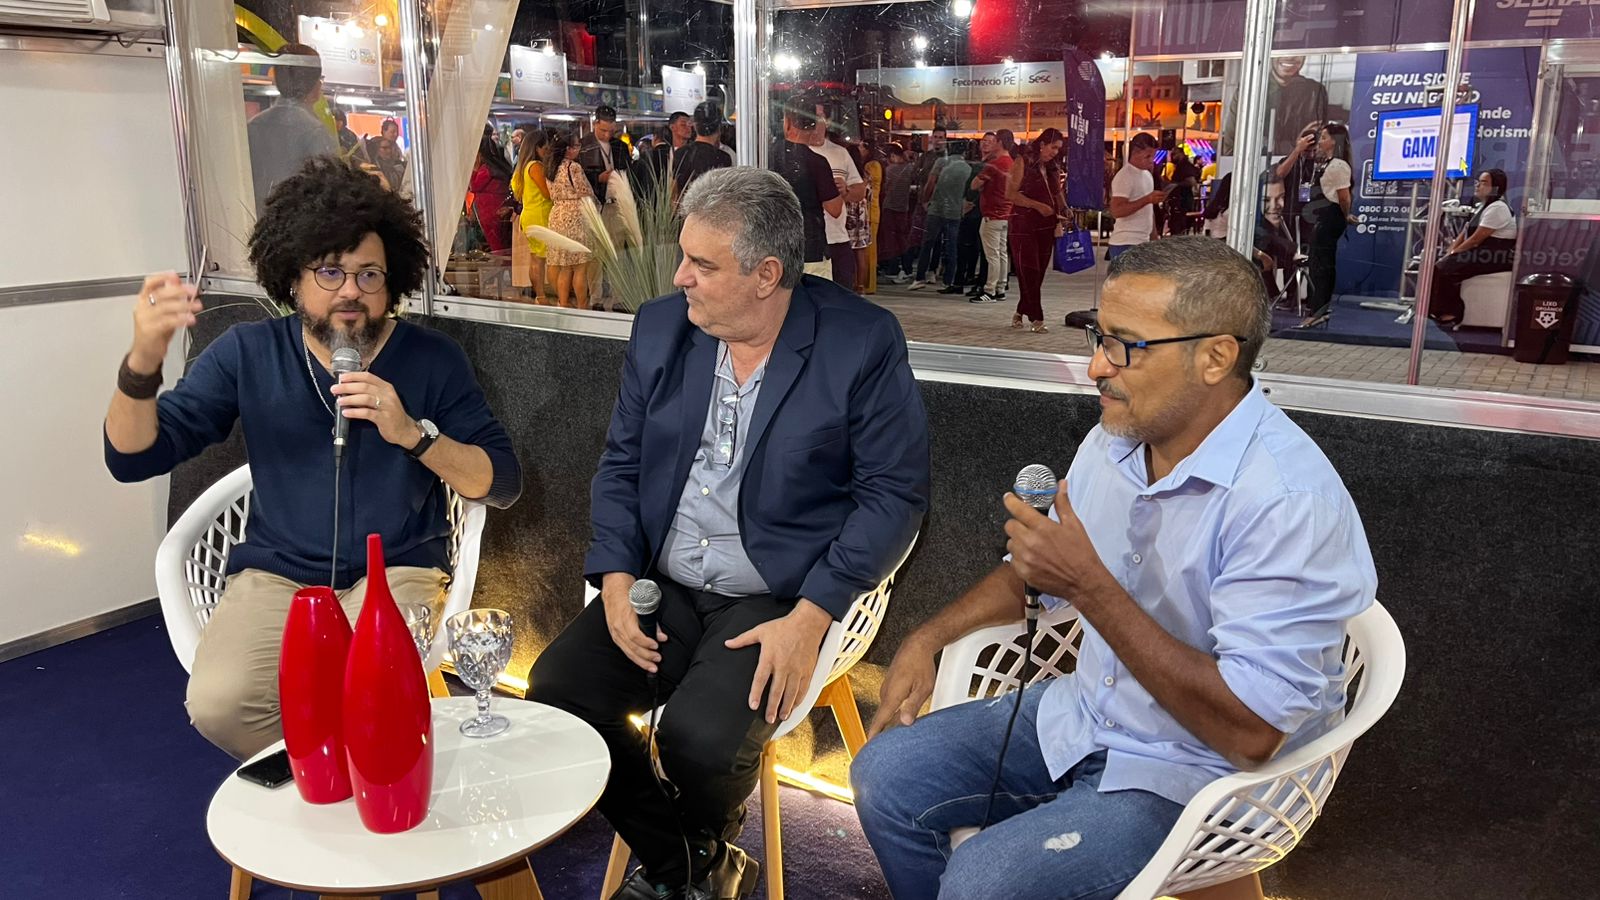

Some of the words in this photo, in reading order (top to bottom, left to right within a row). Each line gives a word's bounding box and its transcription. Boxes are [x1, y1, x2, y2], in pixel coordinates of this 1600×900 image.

[952, 77, 1001, 87] Fecomércio
[1003, 76, 1016, 86] PE
[1028, 74, 1051, 84] Sesc
[1373, 73, 1471, 87] IMPULSIOE
[1371, 92, 1403, 105] SEU
